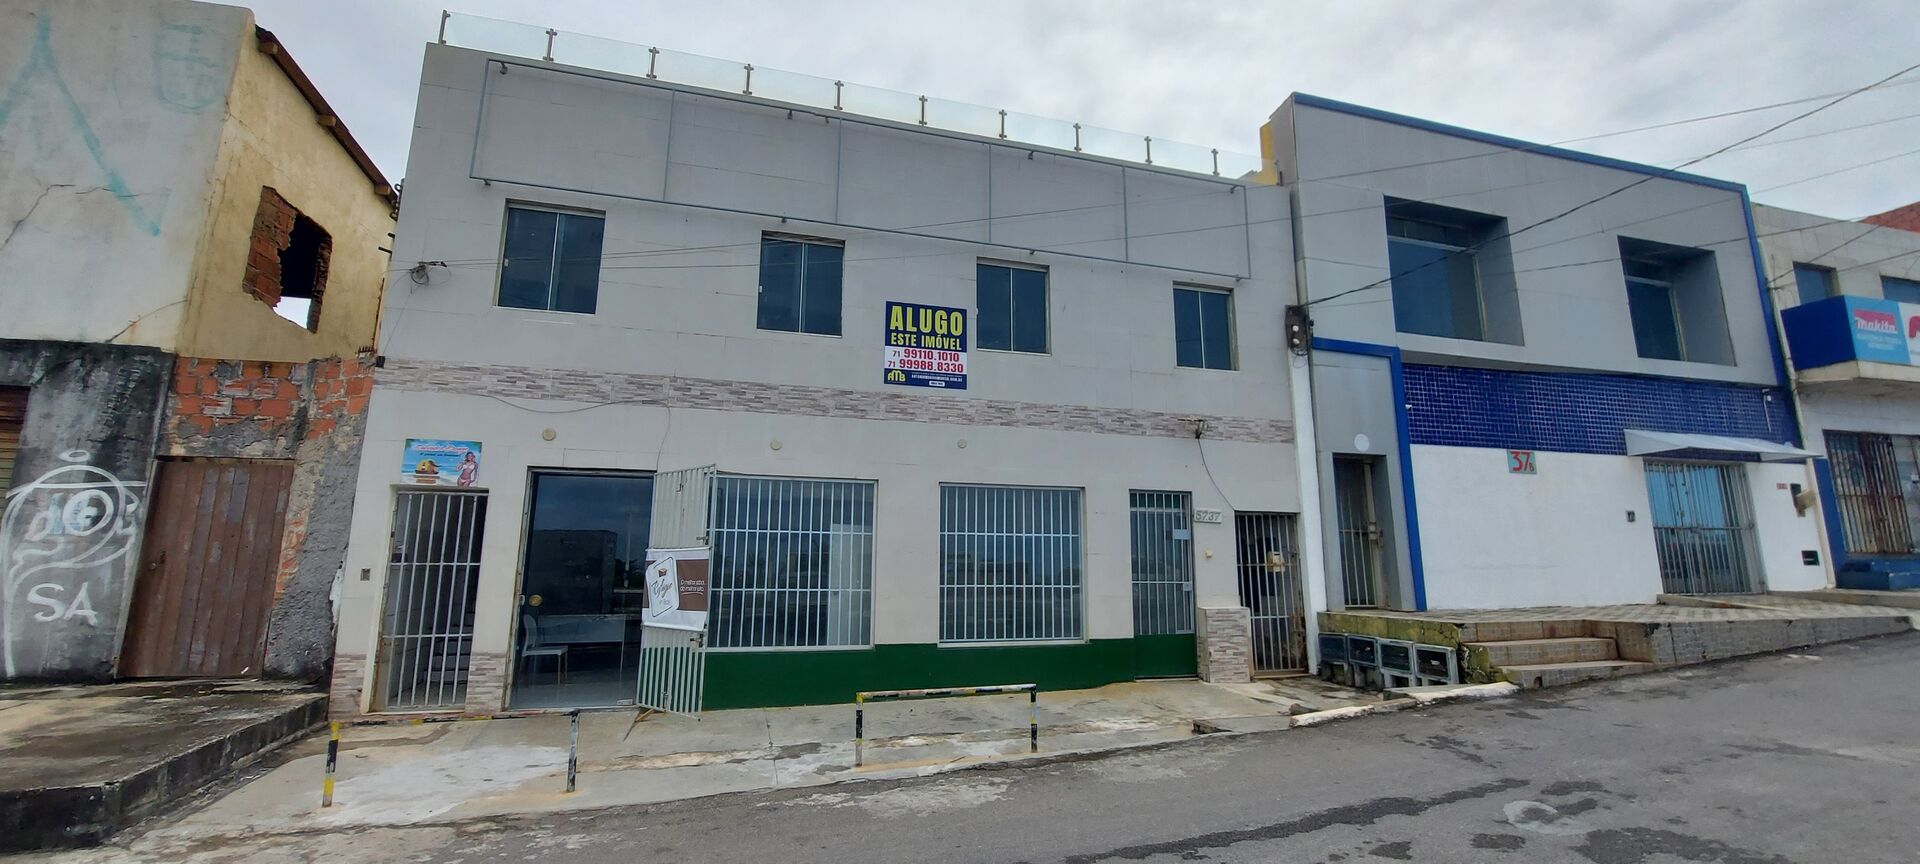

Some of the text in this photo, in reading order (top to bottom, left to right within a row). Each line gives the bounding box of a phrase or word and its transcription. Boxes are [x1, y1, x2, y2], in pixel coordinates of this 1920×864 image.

[890, 306, 962, 336] ALUGO
[891, 333, 962, 350] ESTE IMÓVEL
[904, 349, 959, 362] 99110.1010
[899, 359, 963, 373] 99988.8330
[27, 582, 98, 626] SA
